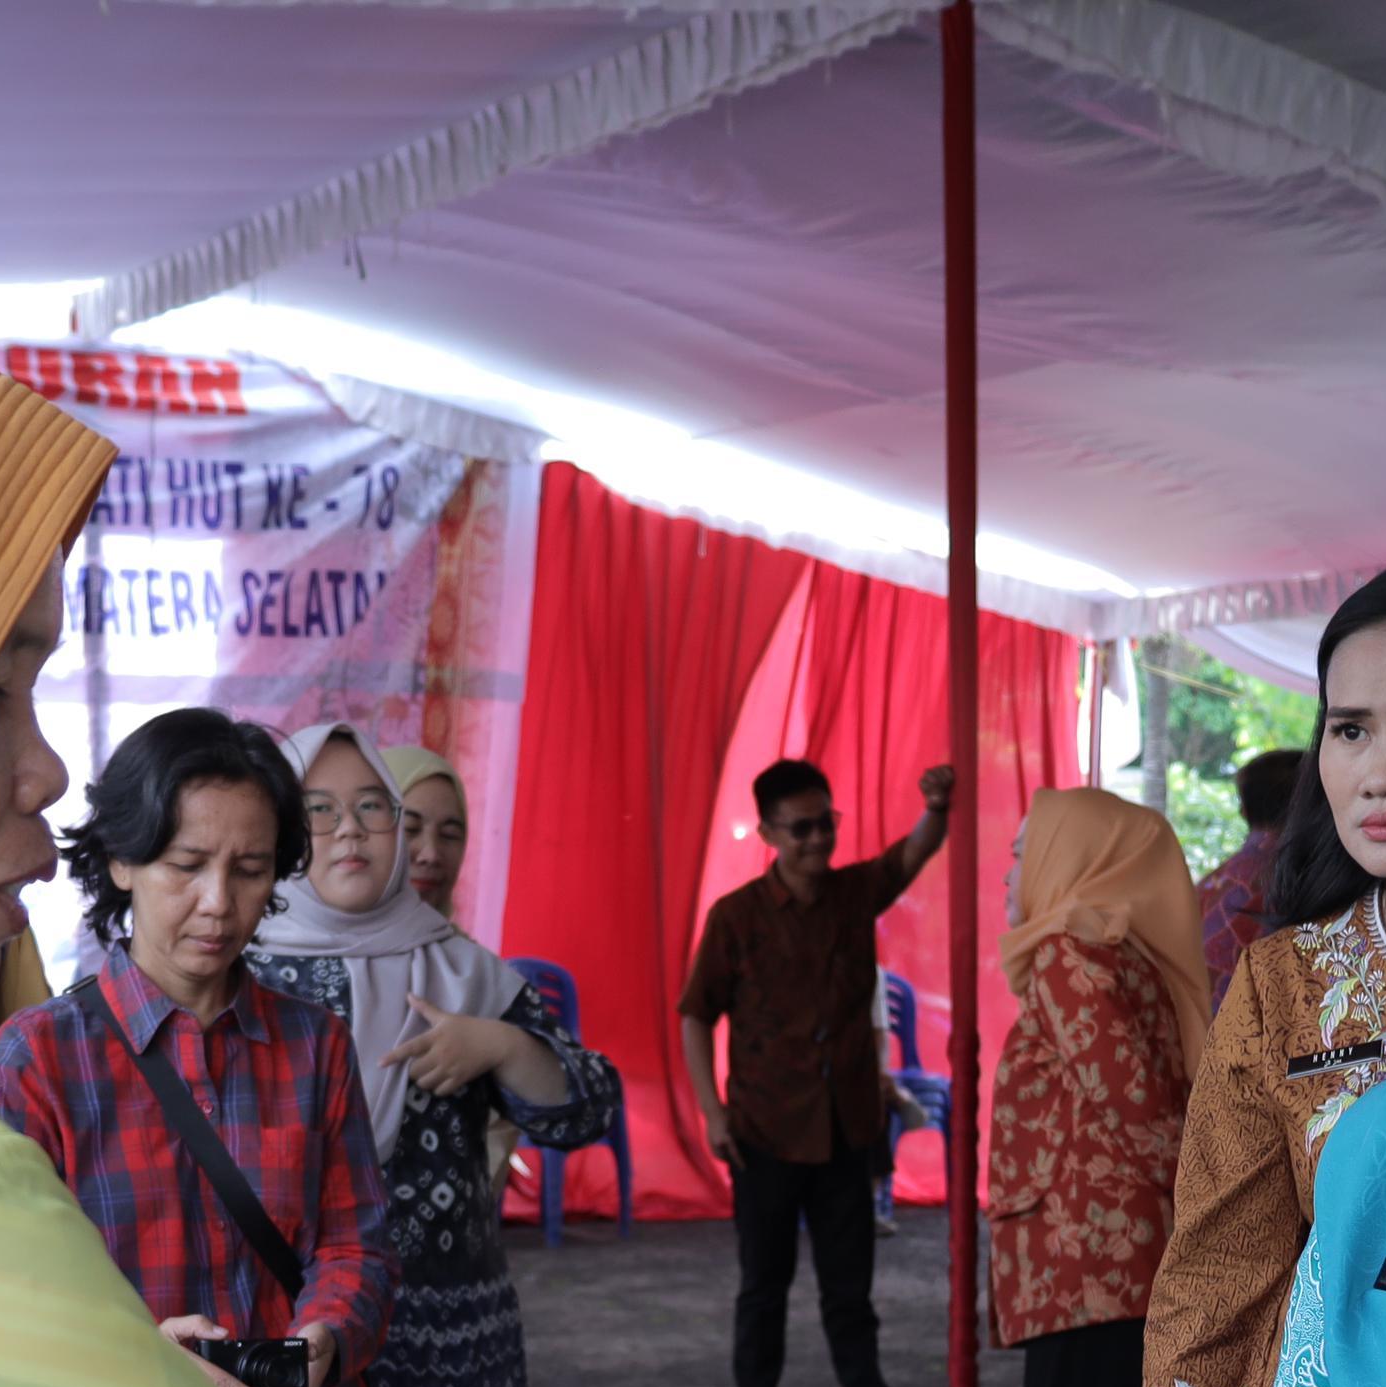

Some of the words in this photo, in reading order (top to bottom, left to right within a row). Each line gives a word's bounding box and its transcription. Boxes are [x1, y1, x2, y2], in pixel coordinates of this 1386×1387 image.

[167, 460, 243, 531] HUT
[262, 463, 309, 530] KE
[353, 464, 399, 530] 78
[1313, 1047, 1353, 1063] HENNY
